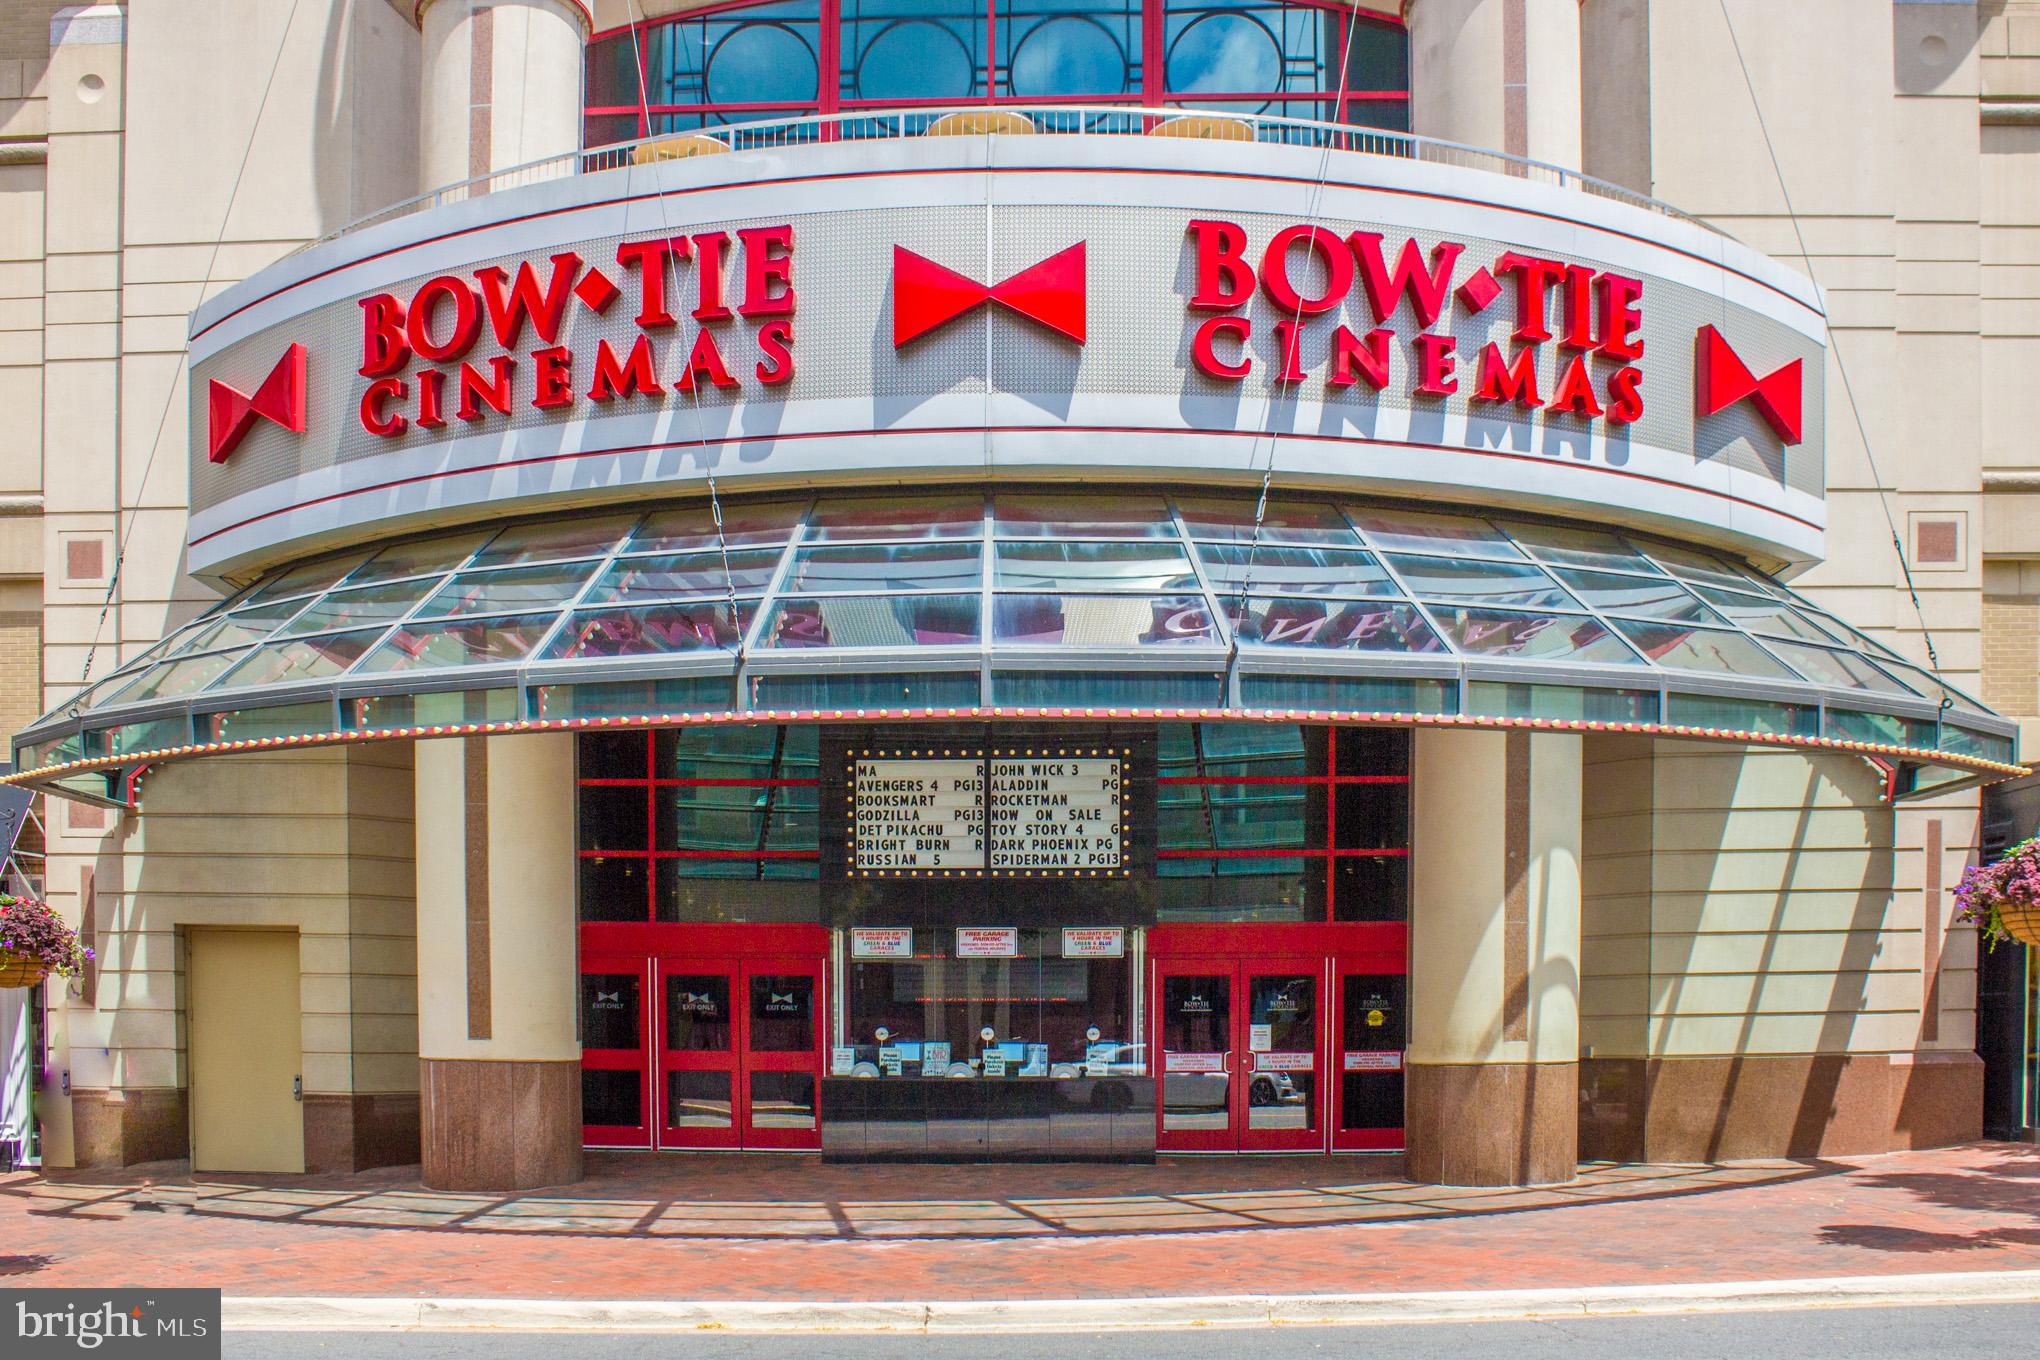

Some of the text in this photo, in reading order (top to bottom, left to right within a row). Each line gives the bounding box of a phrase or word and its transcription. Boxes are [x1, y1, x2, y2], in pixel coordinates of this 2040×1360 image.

[1190, 315, 1643, 426] CINEMAS
[359, 319, 796, 438] CINEMAS
[858, 765, 984, 776] MA R
[991, 765, 1118, 776] JOHN WICK 3 R
[858, 780, 923, 791] AVENGERS
[930, 780, 938, 791] 4
[992, 780, 1118, 790] ALADDIN PG
[857, 795, 983, 806] BOOKSMART R
[991, 795, 1118, 806] ROCKETMAN R
[857, 810, 920, 820] GODZILLA
[991, 810, 1102, 820] NOW ON SALE
[860, 824, 984, 836] DET PIKACHU PG
[991, 824, 1118, 835] TOY STORY 4 G
[858, 840, 982, 850] BRIGHT BURN R
[991, 840, 1112, 850] DARK PHOENIX PG
[858, 854, 940, 866] RUSSIAN 5
[993, 854, 1068, 865] SPIDERMAN
[1074, 854, 1080, 865] 2
